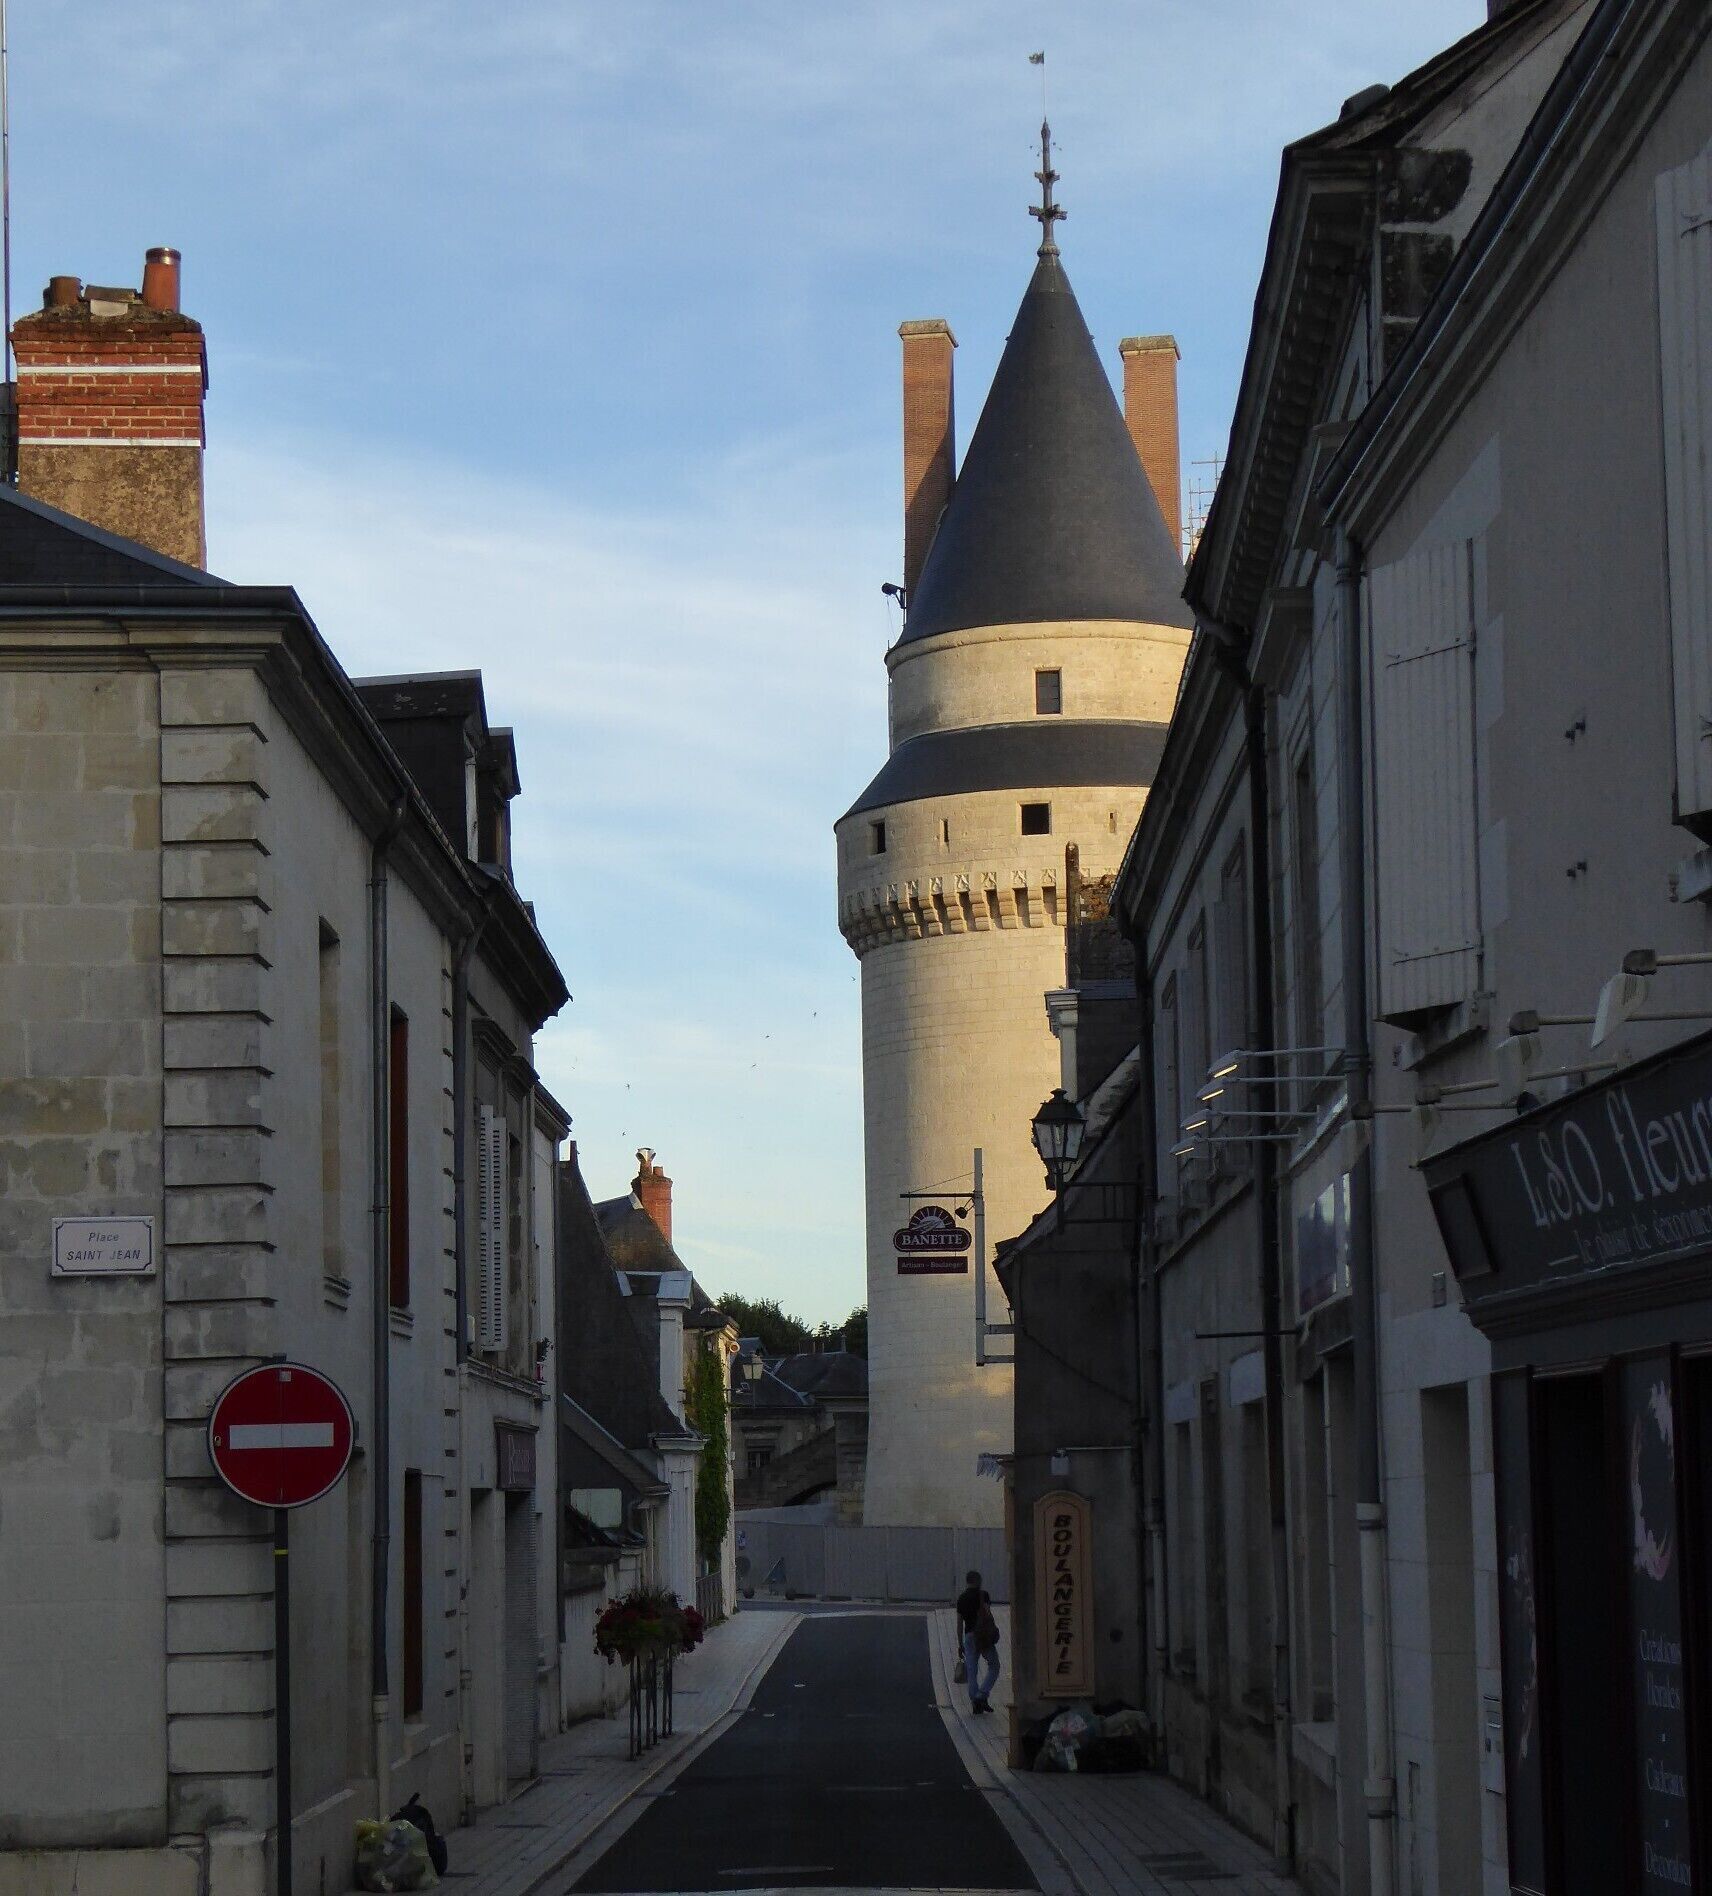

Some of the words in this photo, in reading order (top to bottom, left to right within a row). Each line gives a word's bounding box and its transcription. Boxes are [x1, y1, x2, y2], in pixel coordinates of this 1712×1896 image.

[1606, 1087, 1712, 1203] fleur
[88, 1232, 120, 1242] Place
[901, 1234, 963, 1246] BANETTE
[67, 1250, 103, 1261] SAINT
[110, 1249, 141, 1260] JEAN
[1053, 1514, 1074, 1676] BOULANGERIE
